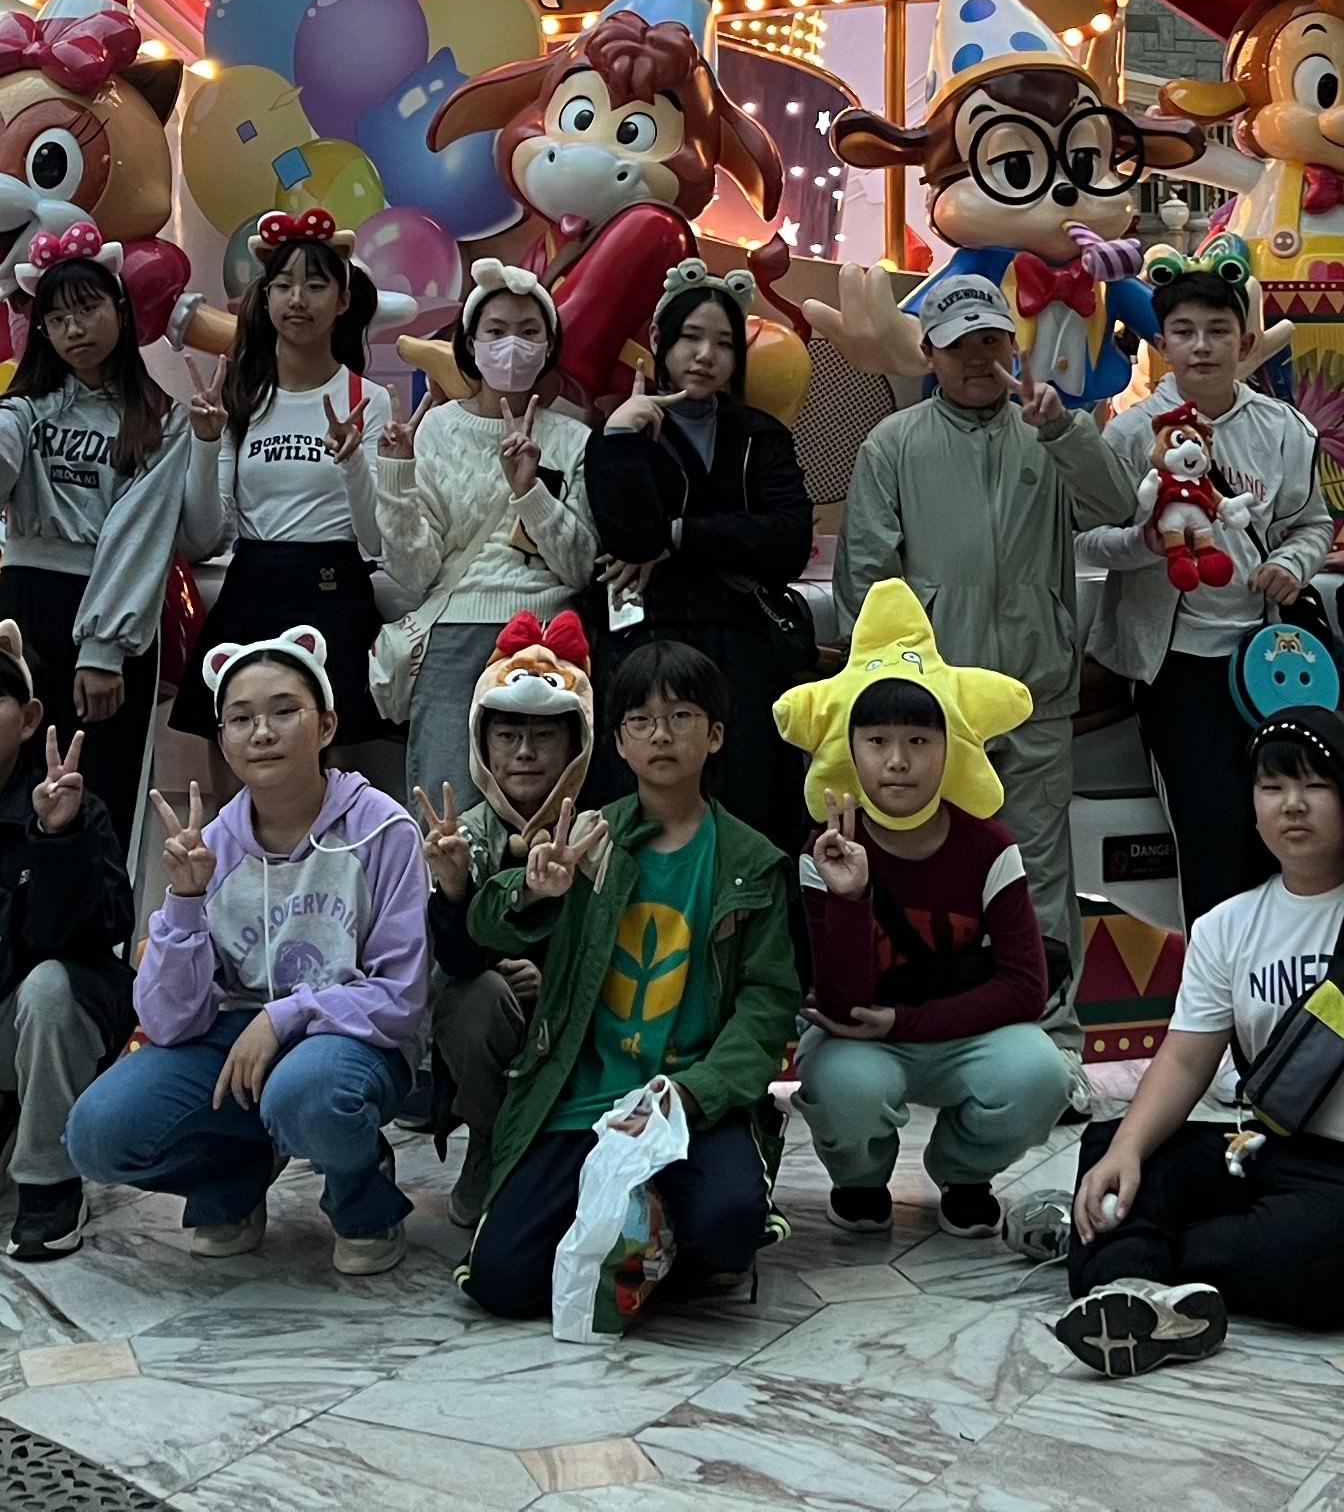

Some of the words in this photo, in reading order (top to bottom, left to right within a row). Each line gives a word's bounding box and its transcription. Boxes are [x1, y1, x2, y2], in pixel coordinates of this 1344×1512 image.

[937, 288, 994, 312] LIFEWORK
[248, 435, 291, 458] BORN
[294, 434, 312, 445] TO
[264, 446, 321, 462] WILD
